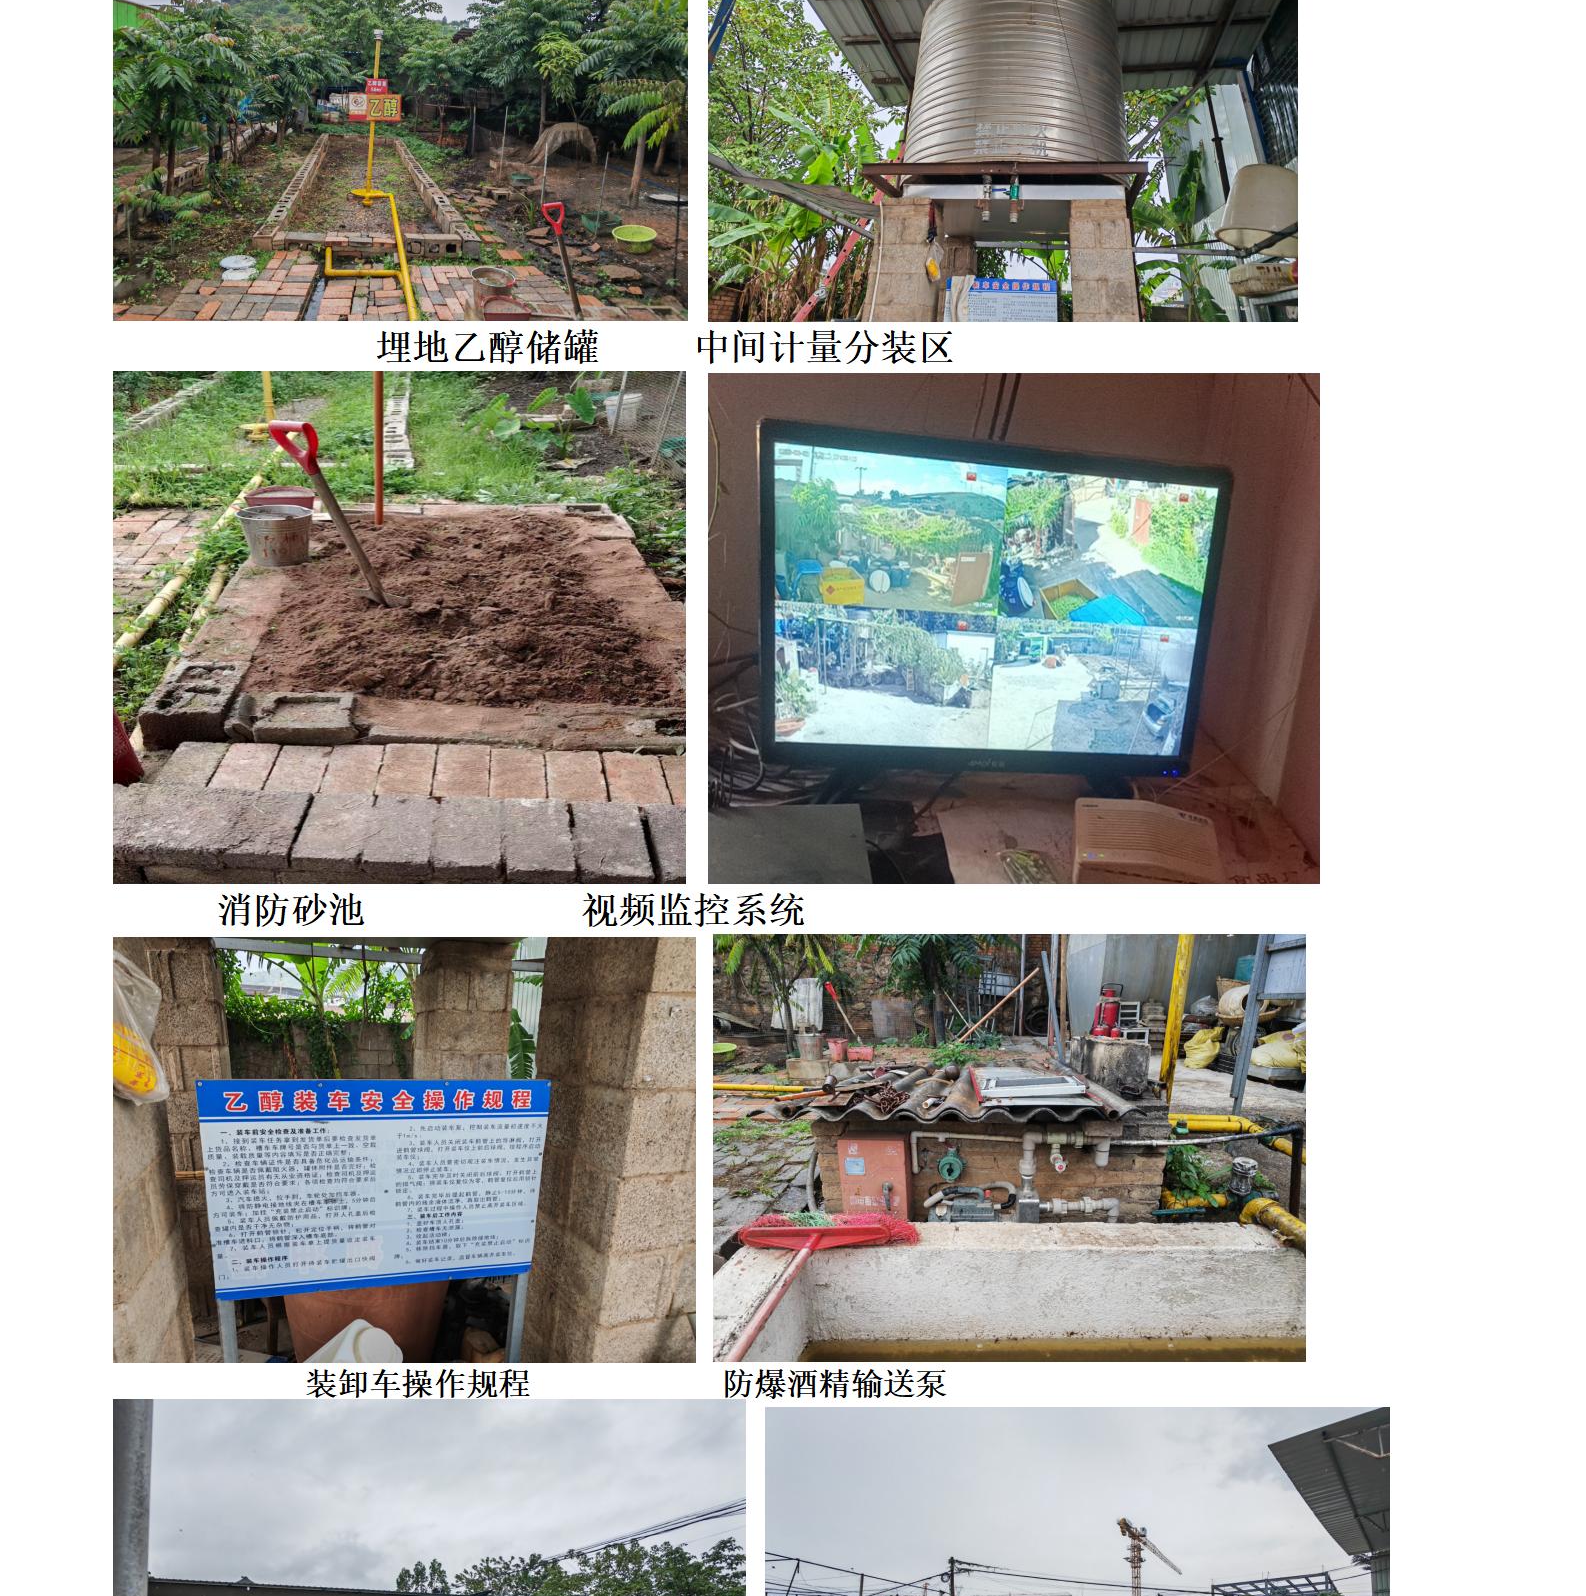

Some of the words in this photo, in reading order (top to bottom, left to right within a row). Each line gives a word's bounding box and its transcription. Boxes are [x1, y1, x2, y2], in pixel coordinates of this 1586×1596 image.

[369, 98, 398, 117] 乙醇
[377, 329, 599, 364] 埋地乙醇储罐
[697, 330, 953, 364] 中间计量分装区
[218, 893, 365, 927] 消防砂池
[581, 893, 805, 927] 视频监控系统
[223, 1089, 533, 1113] 乙醇装车安全操作规程
[306, 1369, 531, 1398] 装卸车操作规程
[724, 1369, 947, 1399] 防爆酒精输送泵
